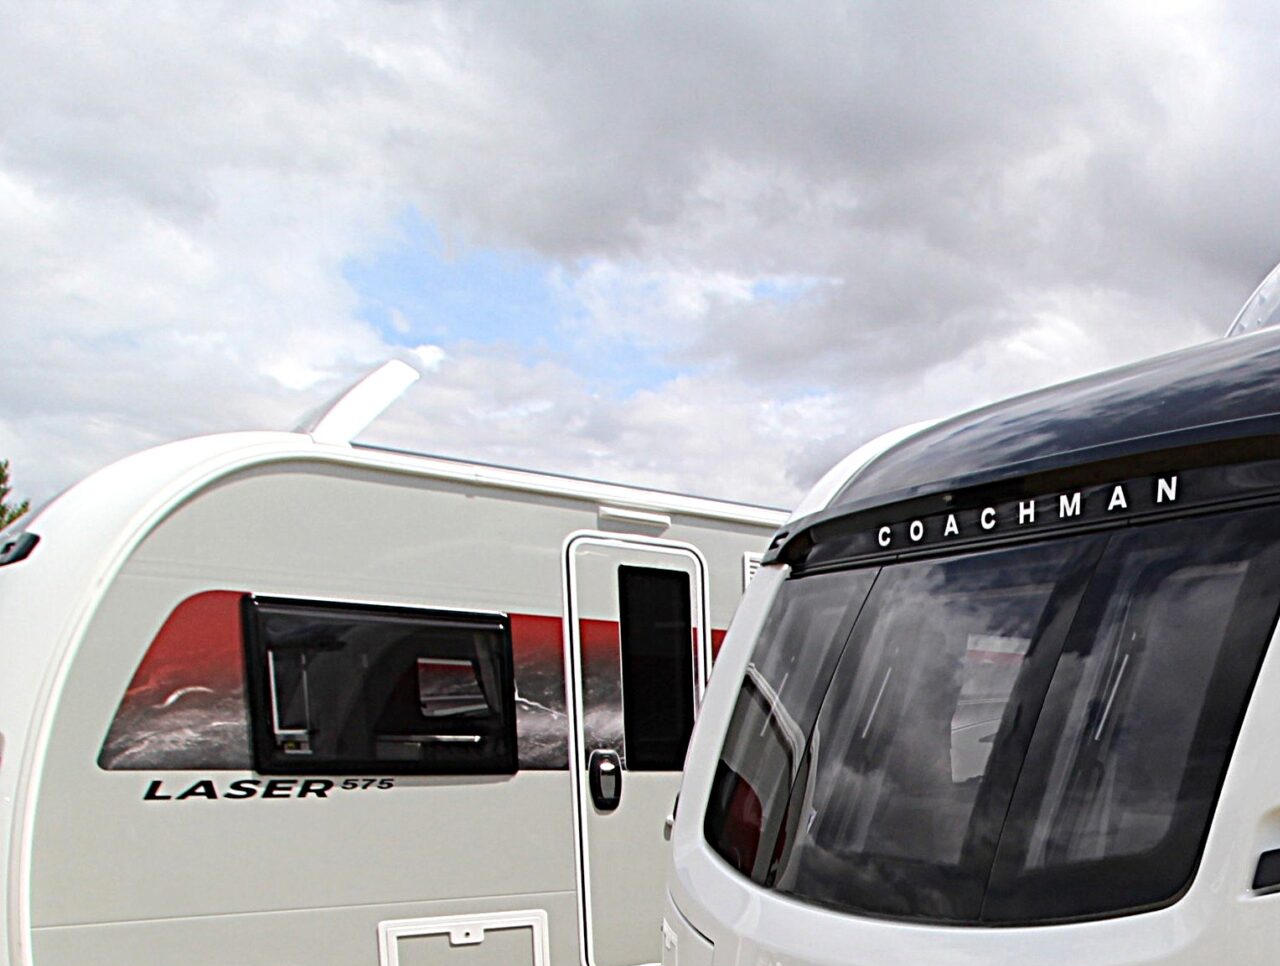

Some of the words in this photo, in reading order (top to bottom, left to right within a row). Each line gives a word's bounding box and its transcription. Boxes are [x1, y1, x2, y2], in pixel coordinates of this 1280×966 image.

[877, 476, 1178, 547] COACHMAN
[143, 779, 334, 801] LASER
[340, 778, 395, 790] 575
